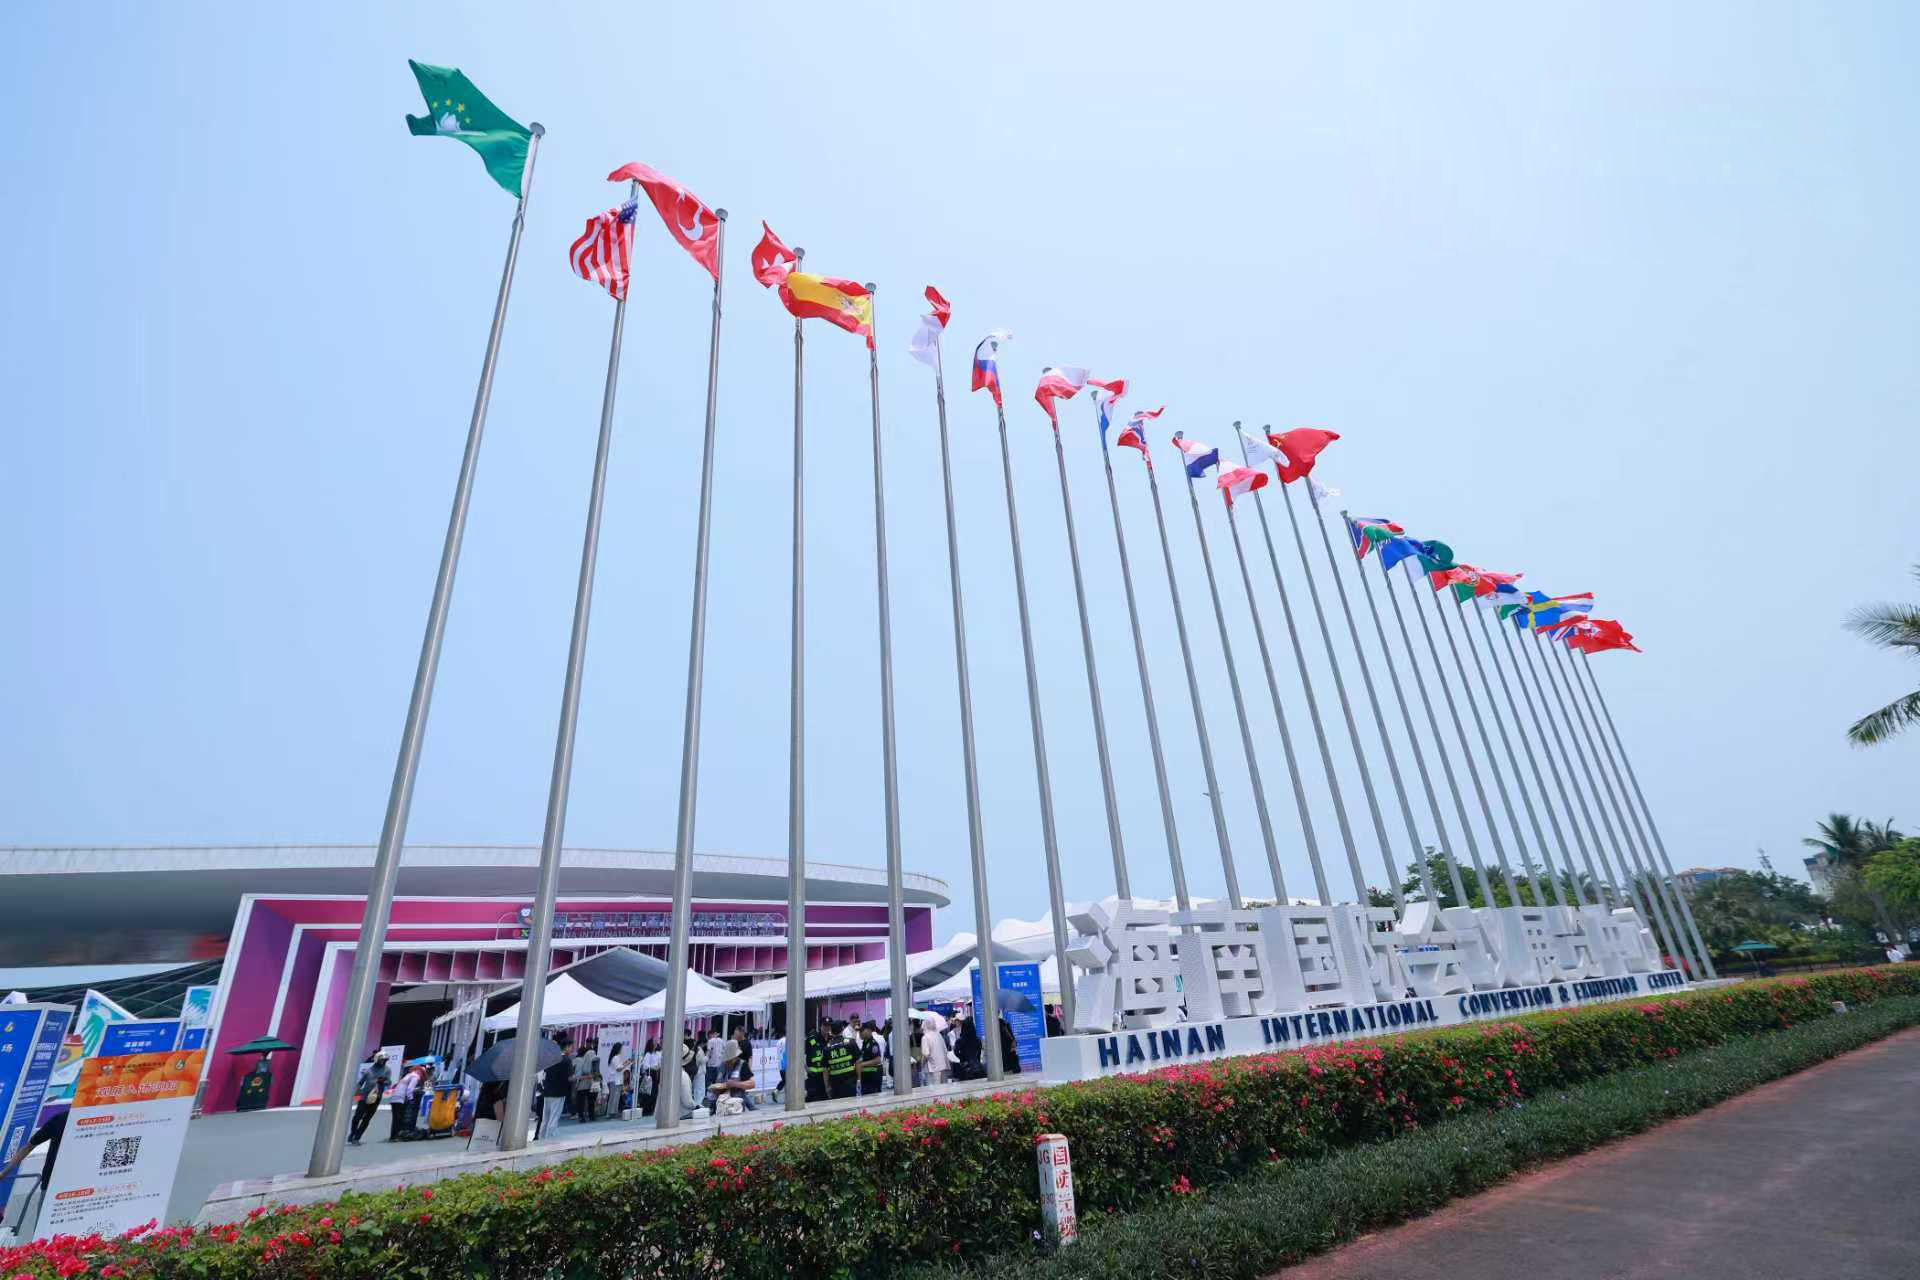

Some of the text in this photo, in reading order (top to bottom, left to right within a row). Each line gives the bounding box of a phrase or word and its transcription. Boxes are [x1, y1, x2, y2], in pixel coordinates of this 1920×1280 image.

[1065, 897, 1663, 1033] 海南国际会展中心
[1097, 970, 1684, 1067] HAINAN INTERNATIONAL CONVENTION & EXHIBITION CENTER
